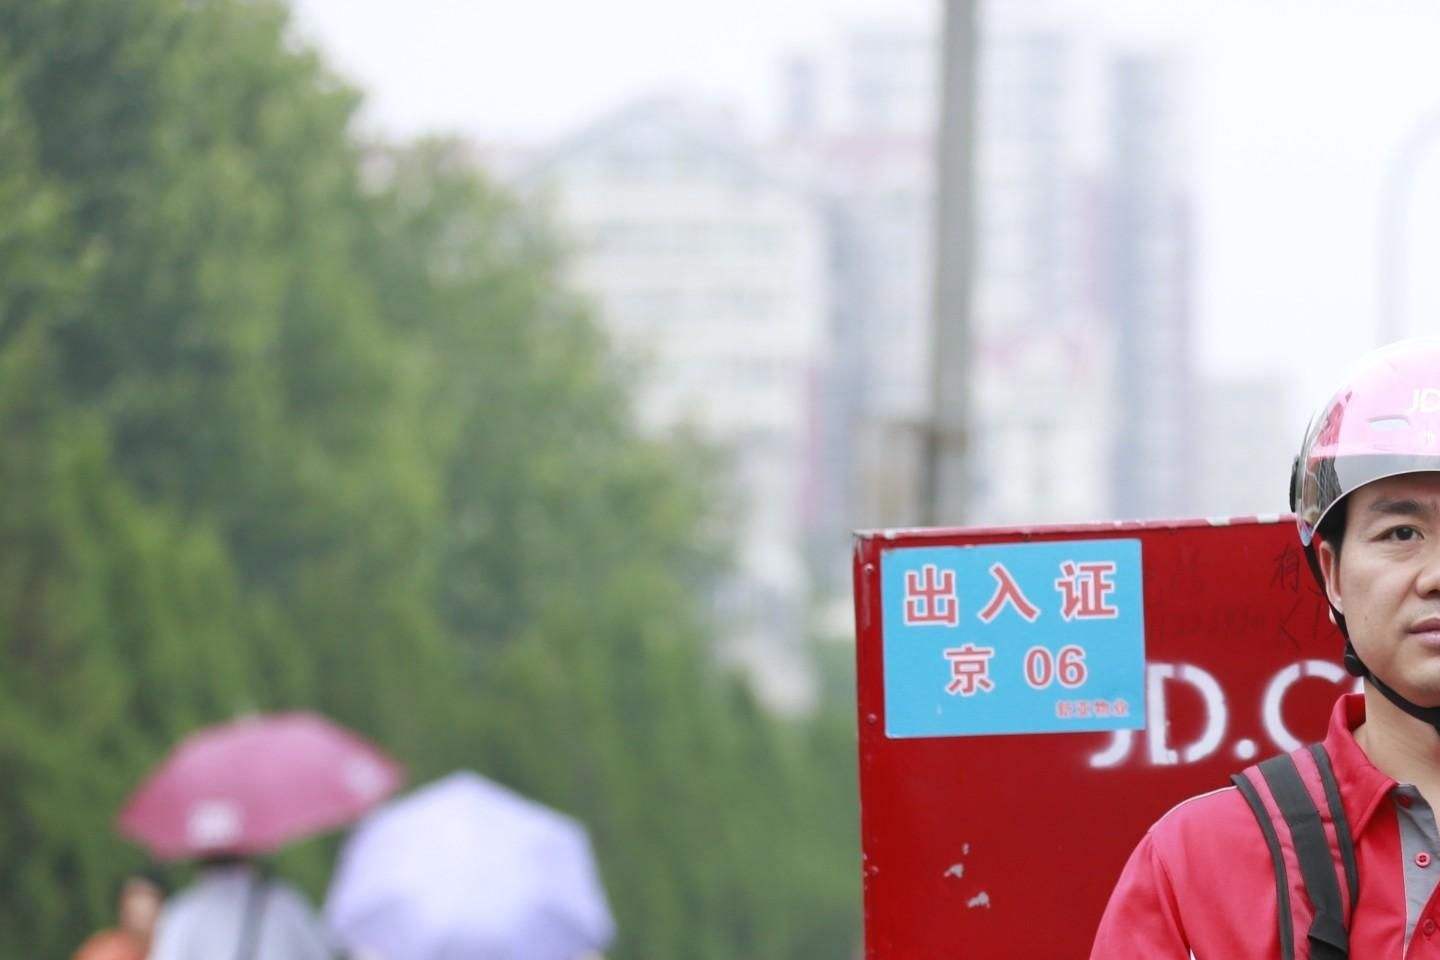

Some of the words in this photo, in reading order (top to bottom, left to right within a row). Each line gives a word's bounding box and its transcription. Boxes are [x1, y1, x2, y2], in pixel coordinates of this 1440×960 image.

[904, 562, 1119, 627] 出入证
[945, 644, 995, 696] 京
[1023, 645, 1089, 690] 06
